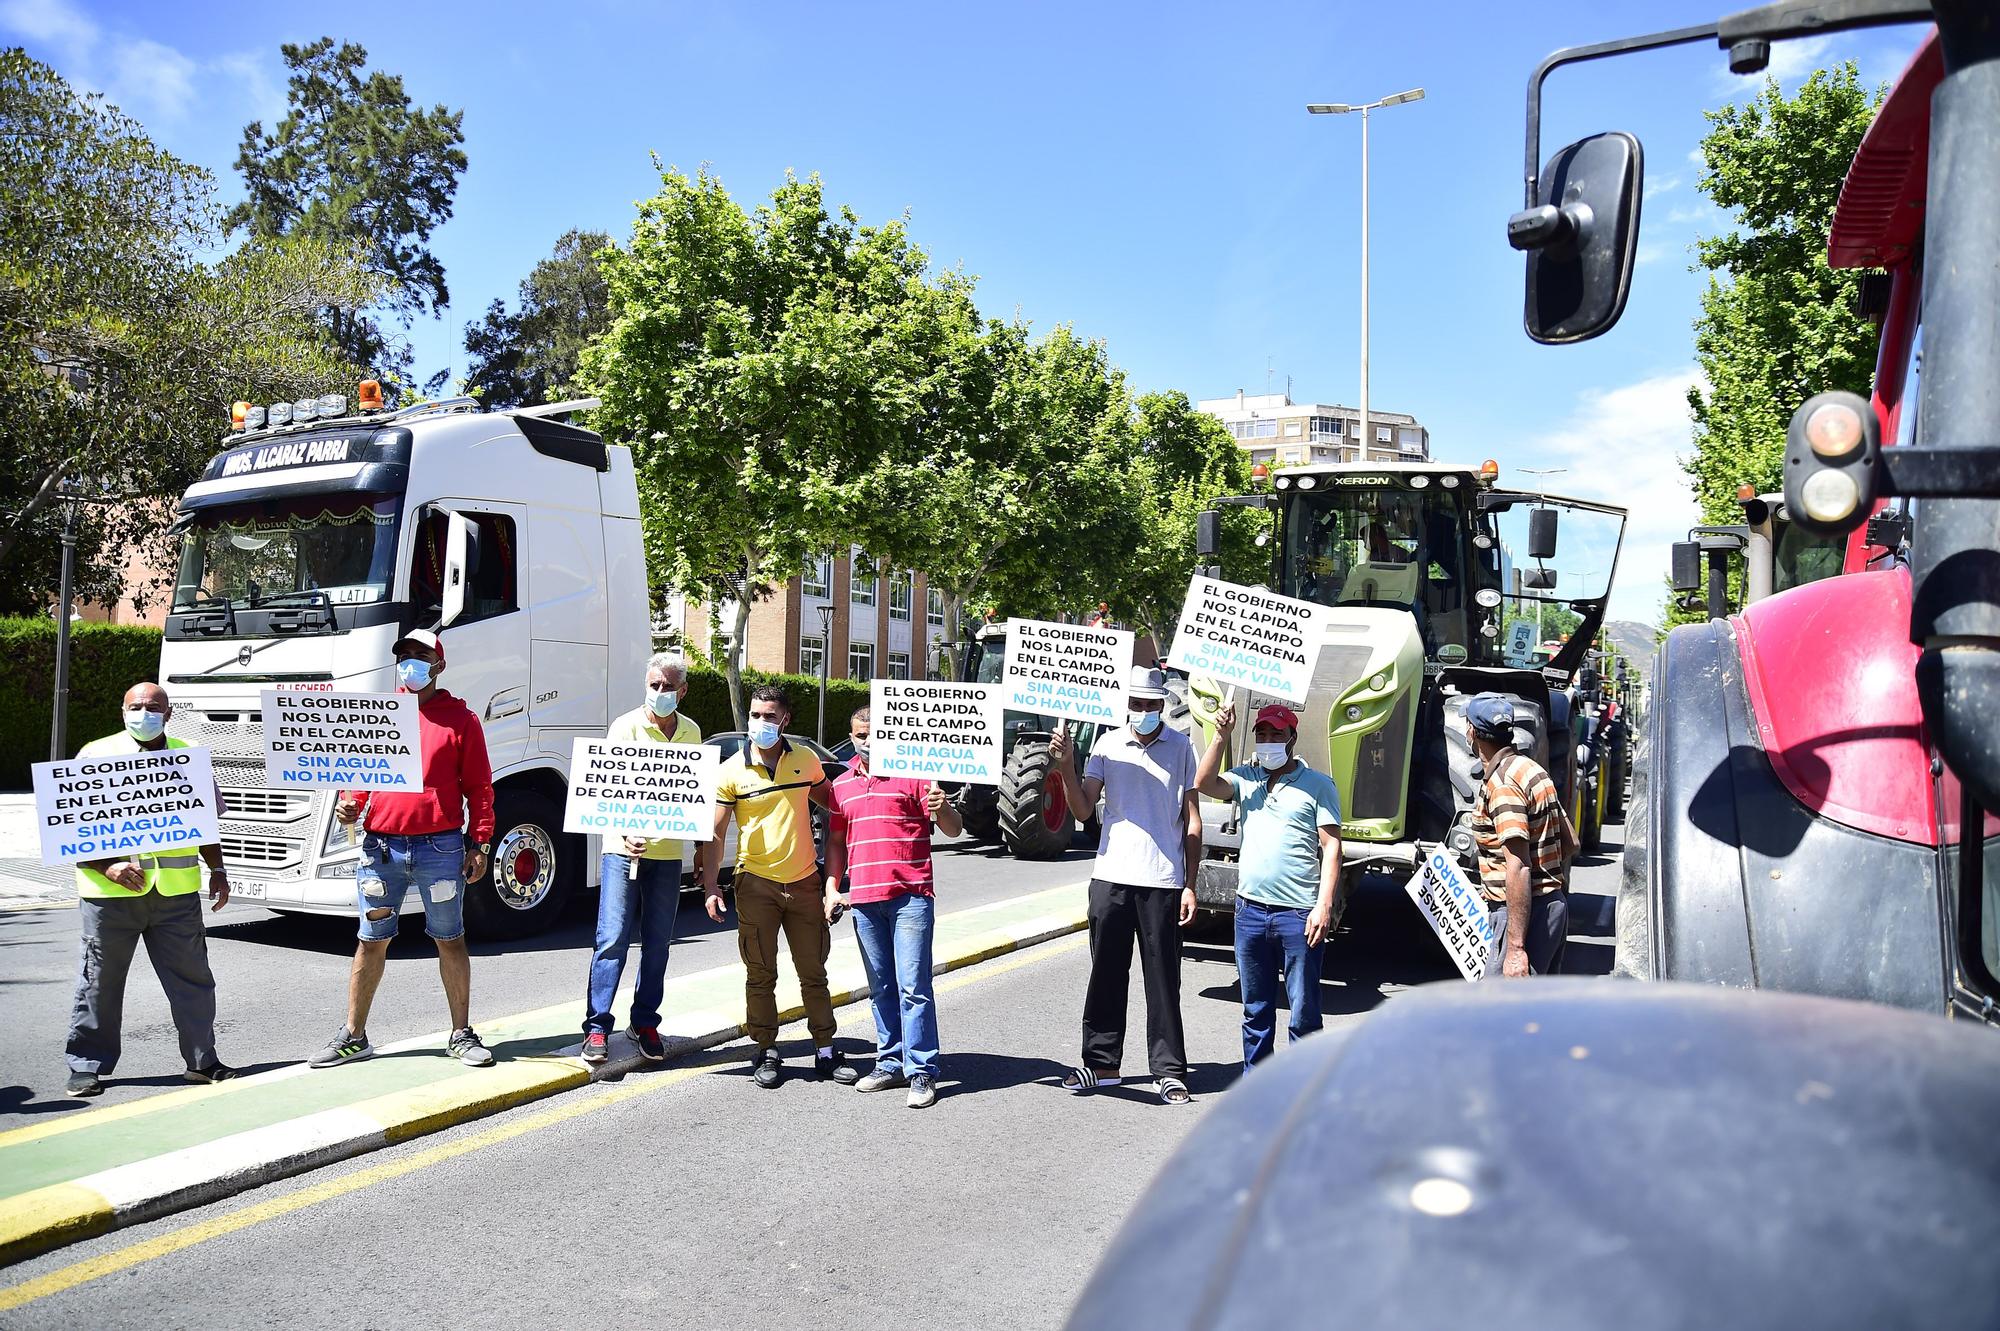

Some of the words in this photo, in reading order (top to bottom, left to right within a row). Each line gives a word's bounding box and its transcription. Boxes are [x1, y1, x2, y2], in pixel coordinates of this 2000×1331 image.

[253, 443, 307, 470] ALCARAZ
[306, 439, 349, 463] PARRA
[1335, 477, 1390, 485] XERION
[257, 521, 289, 529] VOLVO
[340, 589, 366, 602] LATI
[1203, 584, 1220, 596] EL
[1224, 590, 1311, 618] GOBIERNO
[1202, 599, 1236, 615] NOS
[1240, 608, 1302, 634] LAPIDA,
[1019, 625, 1034, 635] EL
[1038, 628, 1117, 645] GOBIERNO
[1195, 612, 1216, 625] EN
[1219, 618, 1236, 631] EL
[1240, 624, 1302, 647] CAMPO
[1021, 639, 1051, 651] NOS
[1055, 643, 1112, 660] LAPIDA,
[1183, 624, 1204, 637] DE
[1207, 631, 1305, 664] CARTAGENA
[1017, 652, 1035, 663] EN
[1039, 655, 1054, 666] EL
[1058, 658, 1114, 674] CAMPO
[1202, 644, 1228, 658] SIN
[1233, 653, 1280, 672] AGUA
[1009, 665, 1027, 676] DE
[1030, 668, 1120, 689] CARTAGENA
[1184, 654, 1208, 667] NO
[1212, 661, 1246, 677] HAY
[1252, 672, 1290, 691] VIDA
[535, 690, 558, 704] 500
[884, 686, 900, 696] EL
[903, 687, 986, 700] GOBIERNO
[1027, 682, 1052, 693] SIN
[1056, 686, 1100, 701] AGUA
[277, 697, 297, 706] EL
[301, 698, 398, 710] GOBIERNO
[887, 701, 919, 711] NOS
[923, 702, 982, 716] LAPIDA,
[1014, 693, 1036, 705] NO
[1040, 697, 1071, 710] HAY
[1075, 702, 1112, 717] VIDA
[282, 712, 321, 722] NOS
[325, 713, 395, 726] LAPIDA,
[883, 715, 902, 725] EN
[906, 716, 923, 726] EL
[926, 717, 985, 730] CAMPO
[279, 726, 302, 736] EN
[307, 727, 327, 737] EL
[331, 728, 400, 739] CAMPO
[876, 729, 895, 740] DE
[898, 731, 992, 745] CARTAGENA
[272, 741, 295, 751] DE
[299, 742, 410, 754] CARTAGENA
[588, 745, 606, 754] EL
[610, 746, 701, 760] GOBIERNO
[896, 745, 922, 756] SIN
[927, 747, 974, 759] AGUA
[52, 767, 76, 778] EL
[81, 754, 189, 774] GOBIERNO
[297, 756, 329, 766] SIN
[334, 757, 389, 768] AGUA
[590, 759, 626, 770] NOS
[630, 761, 696, 776] LAPIDA,
[883, 758, 907, 769] NO
[911, 760, 943, 772] HAY
[948, 763, 987, 775] VIDA
[58, 779, 103, 793] NOS
[109, 770, 187, 787] LAPIDA,
[283, 770, 312, 781] NO
[317, 771, 355, 782] HAY
[359, 772, 406, 783] VIDA
[585, 773, 606, 783] EN
[611, 774, 629, 784] EL
[634, 776, 698, 789] CAMPO
[56, 796, 82, 809] EN
[88, 794, 112, 805] EL
[116, 784, 192, 801] CAMPO
[575, 786, 597, 797] DE
[601, 788, 705, 804] CARTAGENA
[47, 813, 74, 826] DE
[79, 798, 204, 821] CARTAGENA
[598, 802, 626, 812] SIN
[632, 804, 683, 816] AGUA
[77, 823, 114, 837] SIN
[120, 815, 182, 832] AGUA
[581, 815, 608, 826] NO
[613, 818, 649, 828] HAY
[654, 819, 696, 831] VIDA
[60, 841, 95, 855] NO
[101, 834, 144, 850] HAY
[149, 828, 201, 843] VIDA
[1433, 856, 1464, 897] PARO
[246, 883, 263, 896] JGF
[1424, 867, 1466, 927] FAMILIAS
[1463, 895, 1478, 916] AL
[1418, 885, 1463, 953] TRASVASE
[1463, 925, 1478, 946] DE
[1464, 951, 1476, 970] EL
